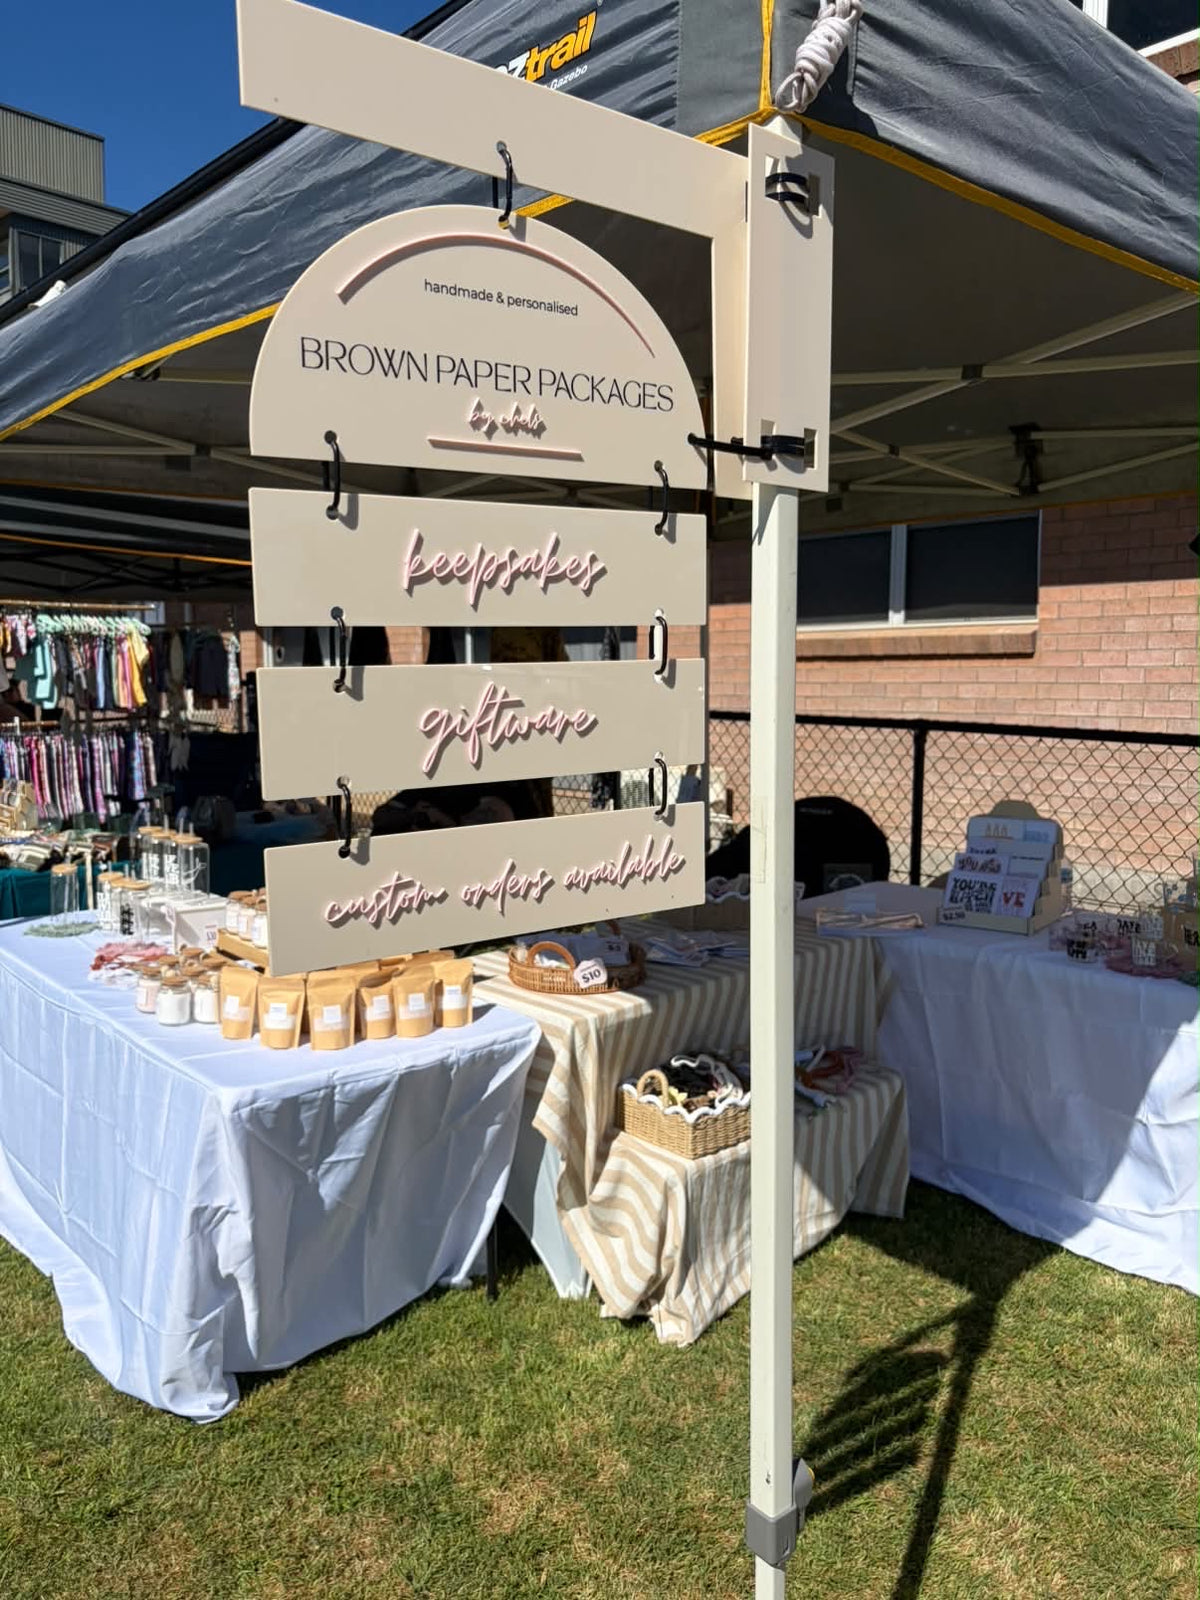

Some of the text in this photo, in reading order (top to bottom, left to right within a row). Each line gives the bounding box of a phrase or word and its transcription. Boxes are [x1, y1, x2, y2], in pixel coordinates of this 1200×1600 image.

[424, 279, 578, 316] handmade & personalised
[300, 336, 674, 412] BROWN PAPER PACKAGES
[468, 397, 495, 432] by
[401, 528, 606, 605] keepsakes
[418, 681, 598, 774] giftware
[324, 833, 686, 924] custom orders available
[582, 968, 601, 983] $10
